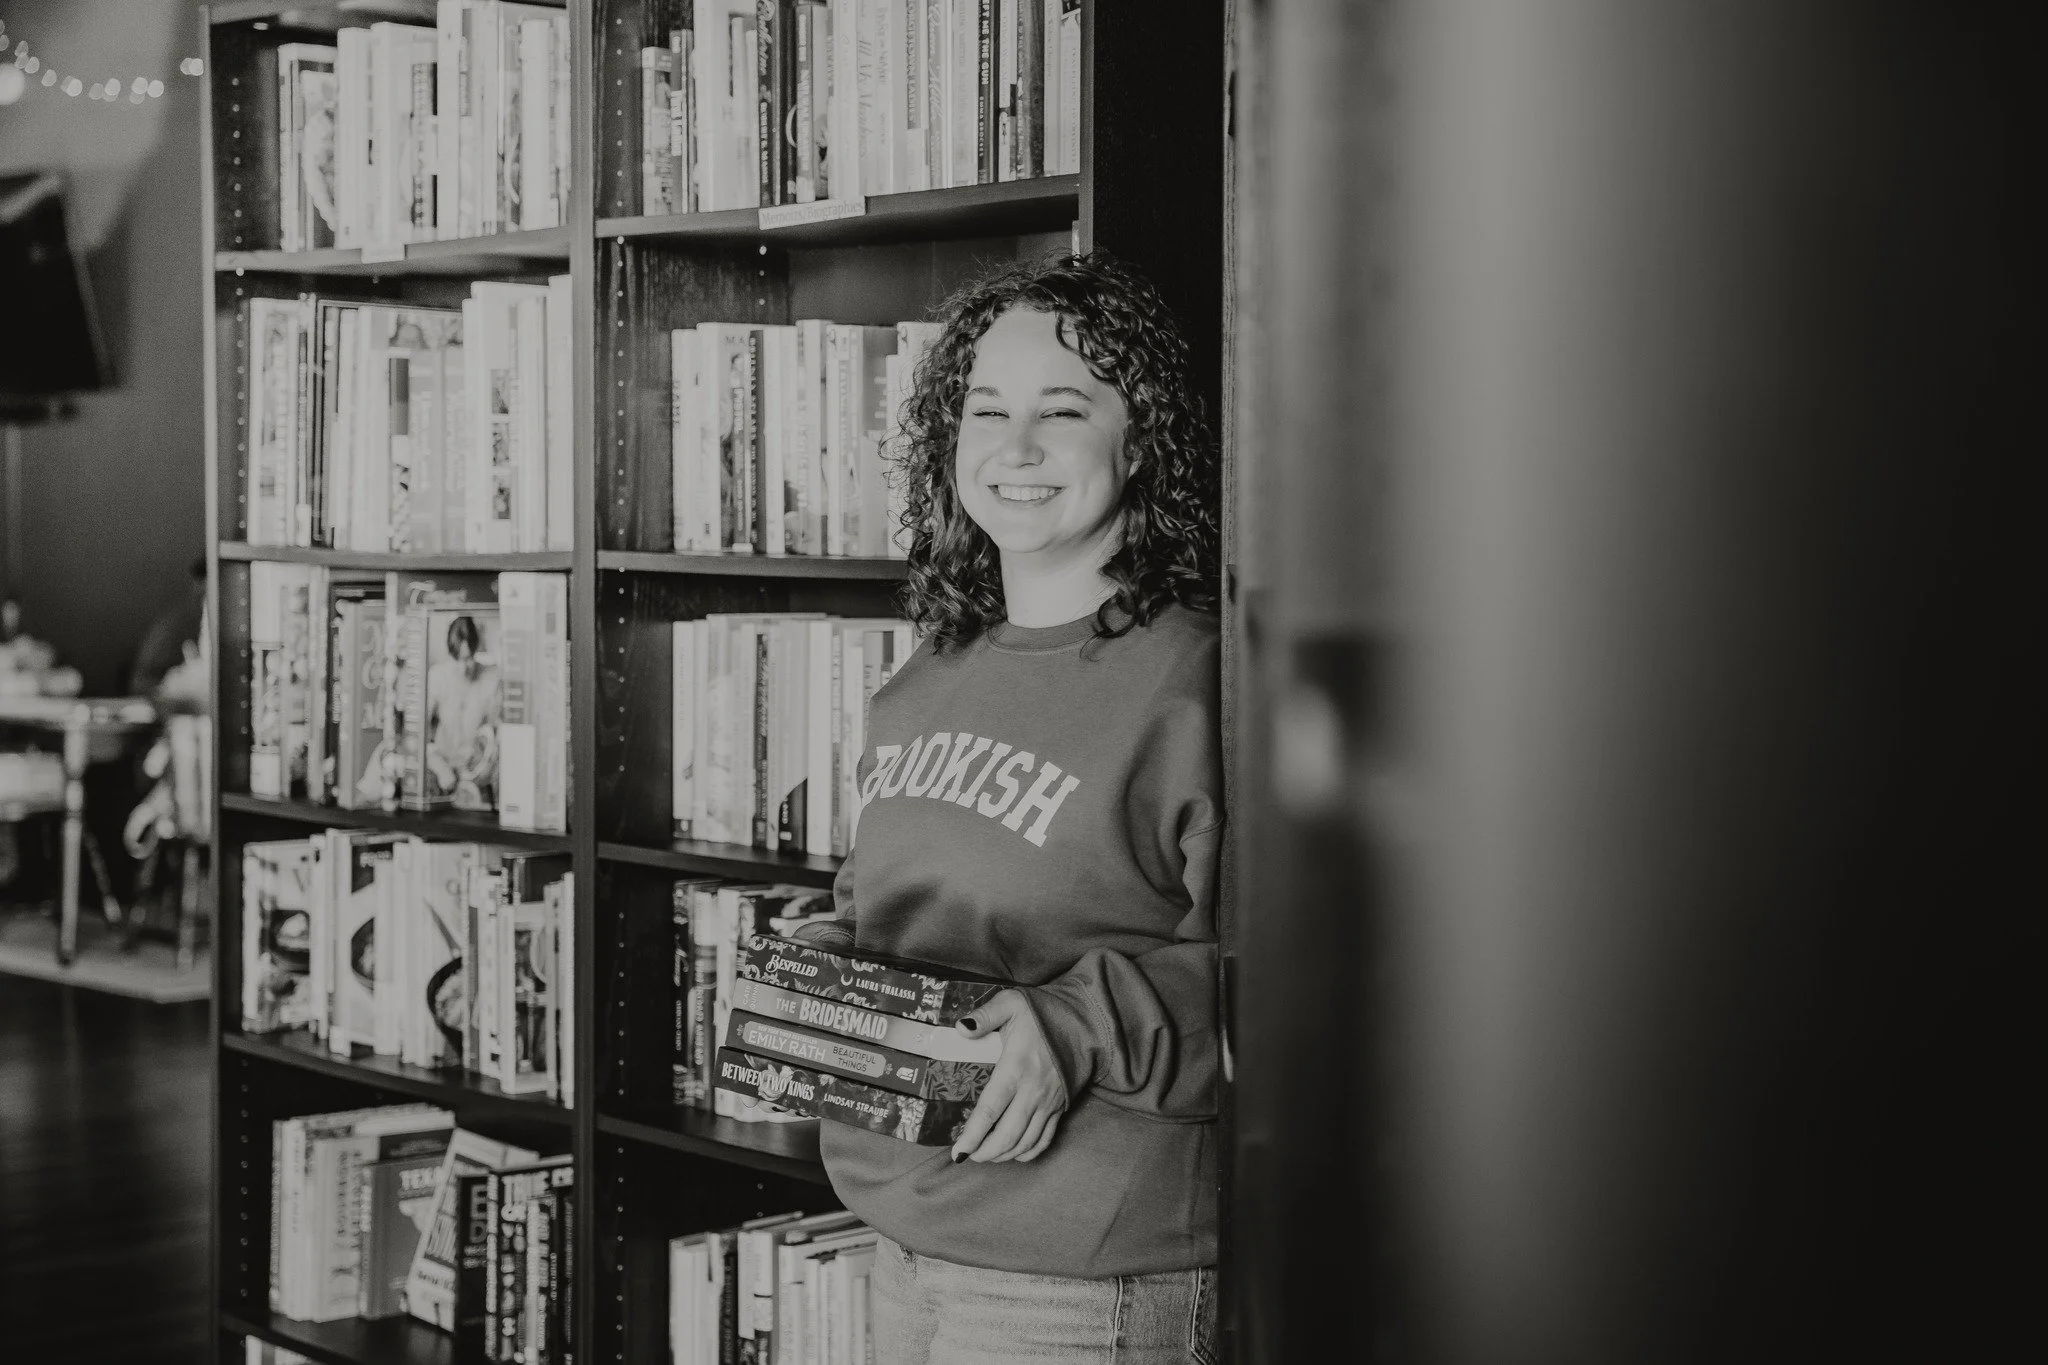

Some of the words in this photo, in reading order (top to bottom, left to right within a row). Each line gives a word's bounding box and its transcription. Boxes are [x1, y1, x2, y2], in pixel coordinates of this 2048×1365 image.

[981, 38, 990, 59] THE
[981, 61, 990, 86] GUN
[862, 732, 1081, 848] BOOKISH
[765, 954, 819, 978] BESPELLED
[856, 978, 879, 992] LAURA
[880, 984, 917, 1001] THALASSA
[776, 997, 797, 1014] THE
[799, 998, 889, 1040] BRIDESMAID
[748, 1030, 788, 1051] EMILY
[788, 1039, 826, 1062] RATH
[832, 1046, 877, 1065] BEAUTIFUL
[838, 1057, 868, 1072] THINGS
[721, 1061, 763, 1087] BETWEEN
[765, 1073, 789, 1093] TWO
[787, 1080, 815, 1101] KINGS
[823, 1092, 855, 1109] LINDSAY
[856, 1101, 889, 1119] STRAUBE
